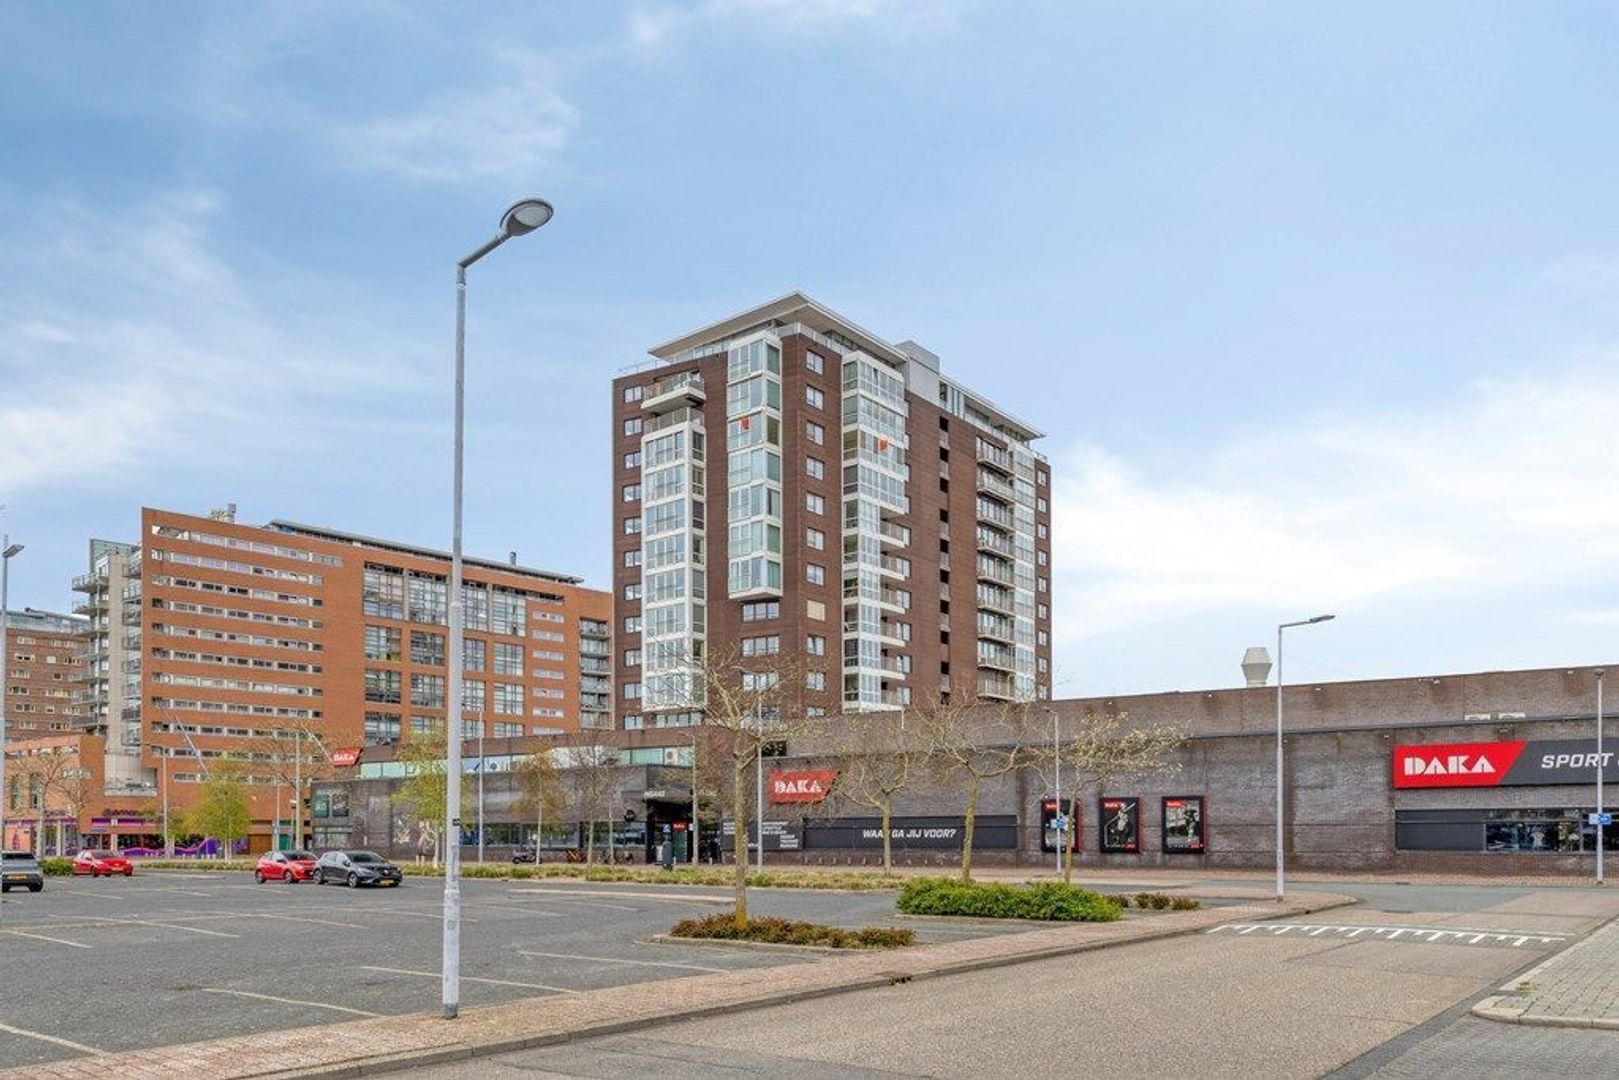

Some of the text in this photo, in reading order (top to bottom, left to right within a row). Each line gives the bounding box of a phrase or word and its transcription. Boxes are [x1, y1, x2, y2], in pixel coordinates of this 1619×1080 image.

[1403, 754, 1496, 776] DAKA
[1541, 752, 1614, 769] SPORT
[774, 779, 822, 793] DAKA
[863, 828, 957, 838] WAA GA JIJ VOOR?
